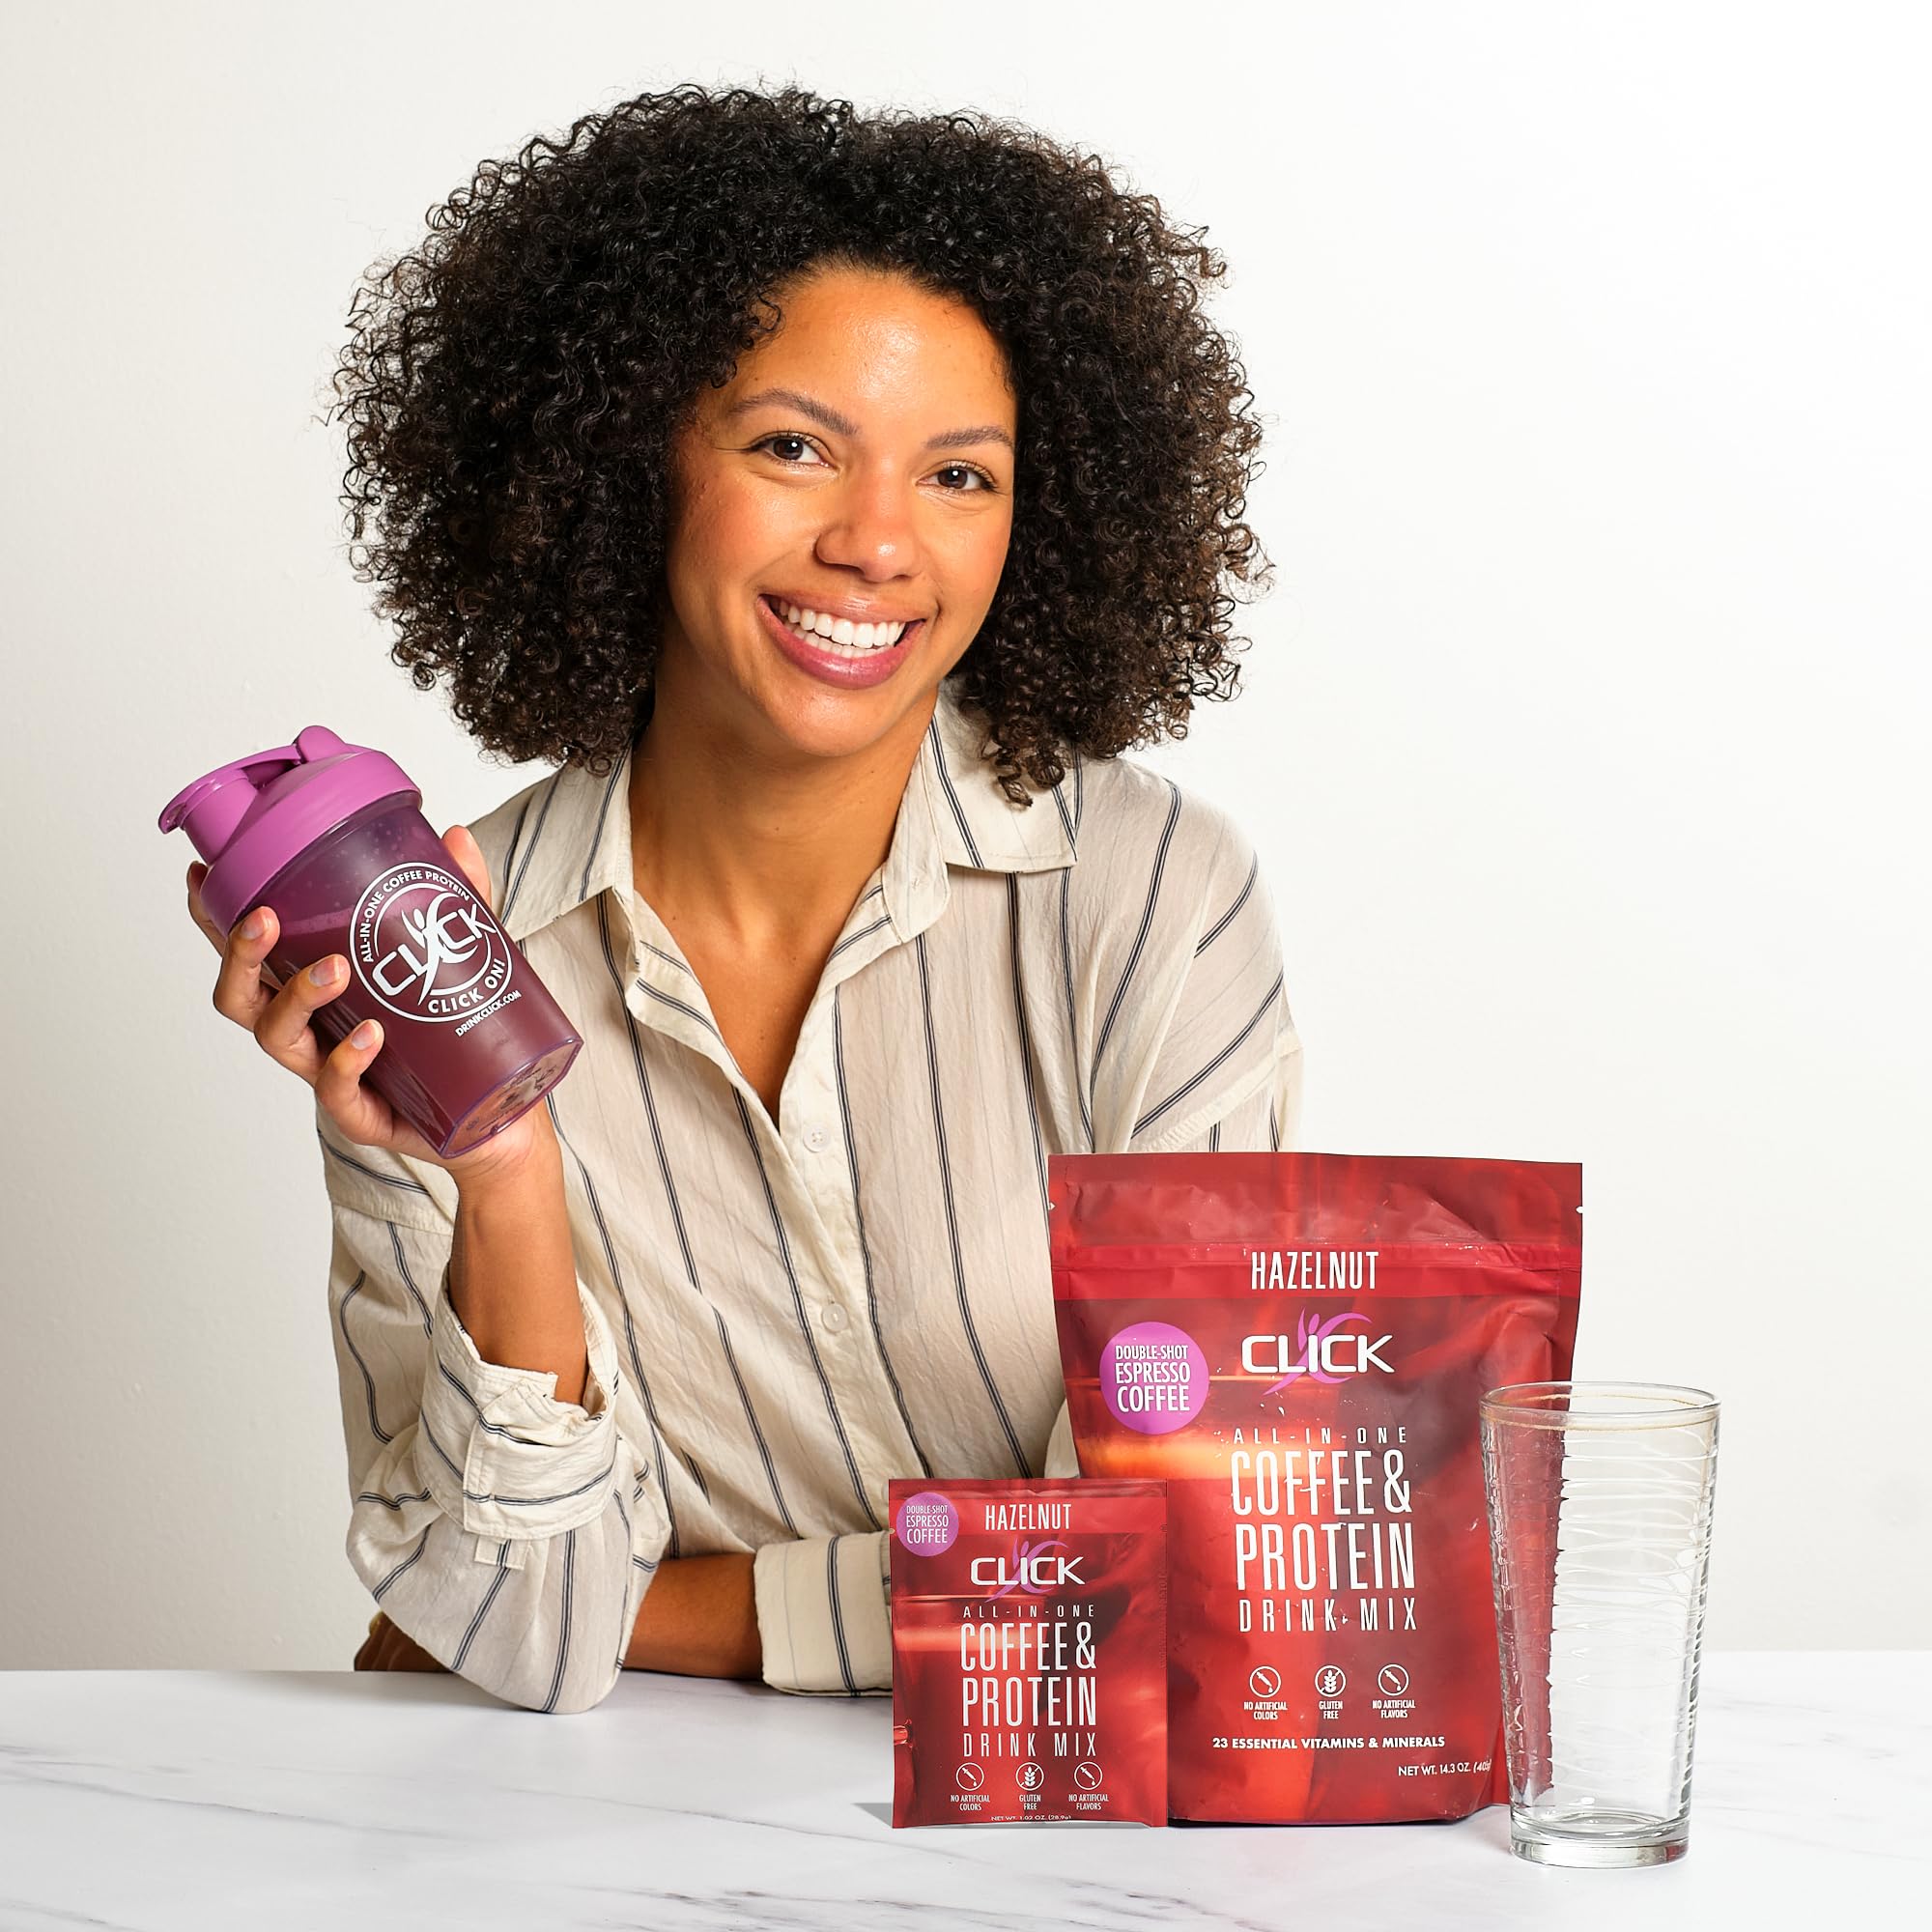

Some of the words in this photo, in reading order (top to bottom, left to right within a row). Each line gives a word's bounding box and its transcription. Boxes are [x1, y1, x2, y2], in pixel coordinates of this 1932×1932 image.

[359, 891, 384, 963] ALL-IN-ONE
[383, 869, 423, 893] COFFEE
[425, 870, 469, 901] PROTEIN
[428, 987, 485, 1013] CLICK
[484, 958, 505, 989] ON!
[455, 990, 522, 1037] DRINKCLICK.COM
[1250, 1251, 1379, 1291] HAZELNUT
[1115, 1345, 1189, 1361] DOUBLE-SHOT
[1241, 1334, 1396, 1374] CLICK
[1115, 1362, 1191, 1385] ESPRESSO
[1117, 1384, 1190, 1413] COFFEE
[1233, 1426, 1407, 1445] ALL-IN-ONE
[1231, 1450, 1375, 1516] COFFEE
[1383, 1449, 1413, 1514] &
[906, 1504, 948, 1514] DOUBLE-SHOT
[984, 1503, 1072, 1531] HAZELNUT
[906, 1515, 949, 1527] ESPRESSO
[907, 1528, 948, 1544] COFFEE
[1236, 1522, 1415, 1591] PROTEIN
[970, 1556, 1086, 1585] CLICK
[963, 1605, 1094, 1618] ALL-IN-ONE
[1238, 1599, 1337, 1633] DRINK
[1360, 1597, 1417, 1632] MIX
[960, 1622, 1068, 1671] COFFEE
[1075, 1621, 1097, 1669] &
[962, 1676, 1097, 1727] PROTEIN
[1244, 1701, 1253, 1711] NO
[1254, 1701, 1288, 1711] ARTIFICIAL
[1319, 1700, 1343, 1710] GLUTEN
[1372, 1700, 1382, 1709] NO
[1383, 1699, 1416, 1709] ARTIFICIAL
[1253, 1711, 1278, 1720] COLORS
[1323, 1710, 1339, 1719] FREE
[1380, 1709, 1408, 1719] FLAVORS
[964, 1733, 1037, 1757] DRINK
[1054, 1732, 1097, 1757] MIX
[1212, 1737, 1229, 1748] 23
[1232, 1738, 1297, 1749] ESSENTIAL
[1302, 1737, 1365, 1749] VITAMINS
[1369, 1737, 1378, 1748] &
[1382, 1736, 1445, 1748] MINERALS
[1398, 1766, 1419, 1776] NET
[1421, 1765, 1437, 1776] WT.
[1439, 1763, 1456, 1775] 14.3
[1457, 1762, 1471, 1772] OZ.
[959, 1803, 982, 1811] COLORS
[1076, 1802, 1101, 1810] FLAVORS
[1079, 1794, 1109, 1803] ARTIFICIAL
